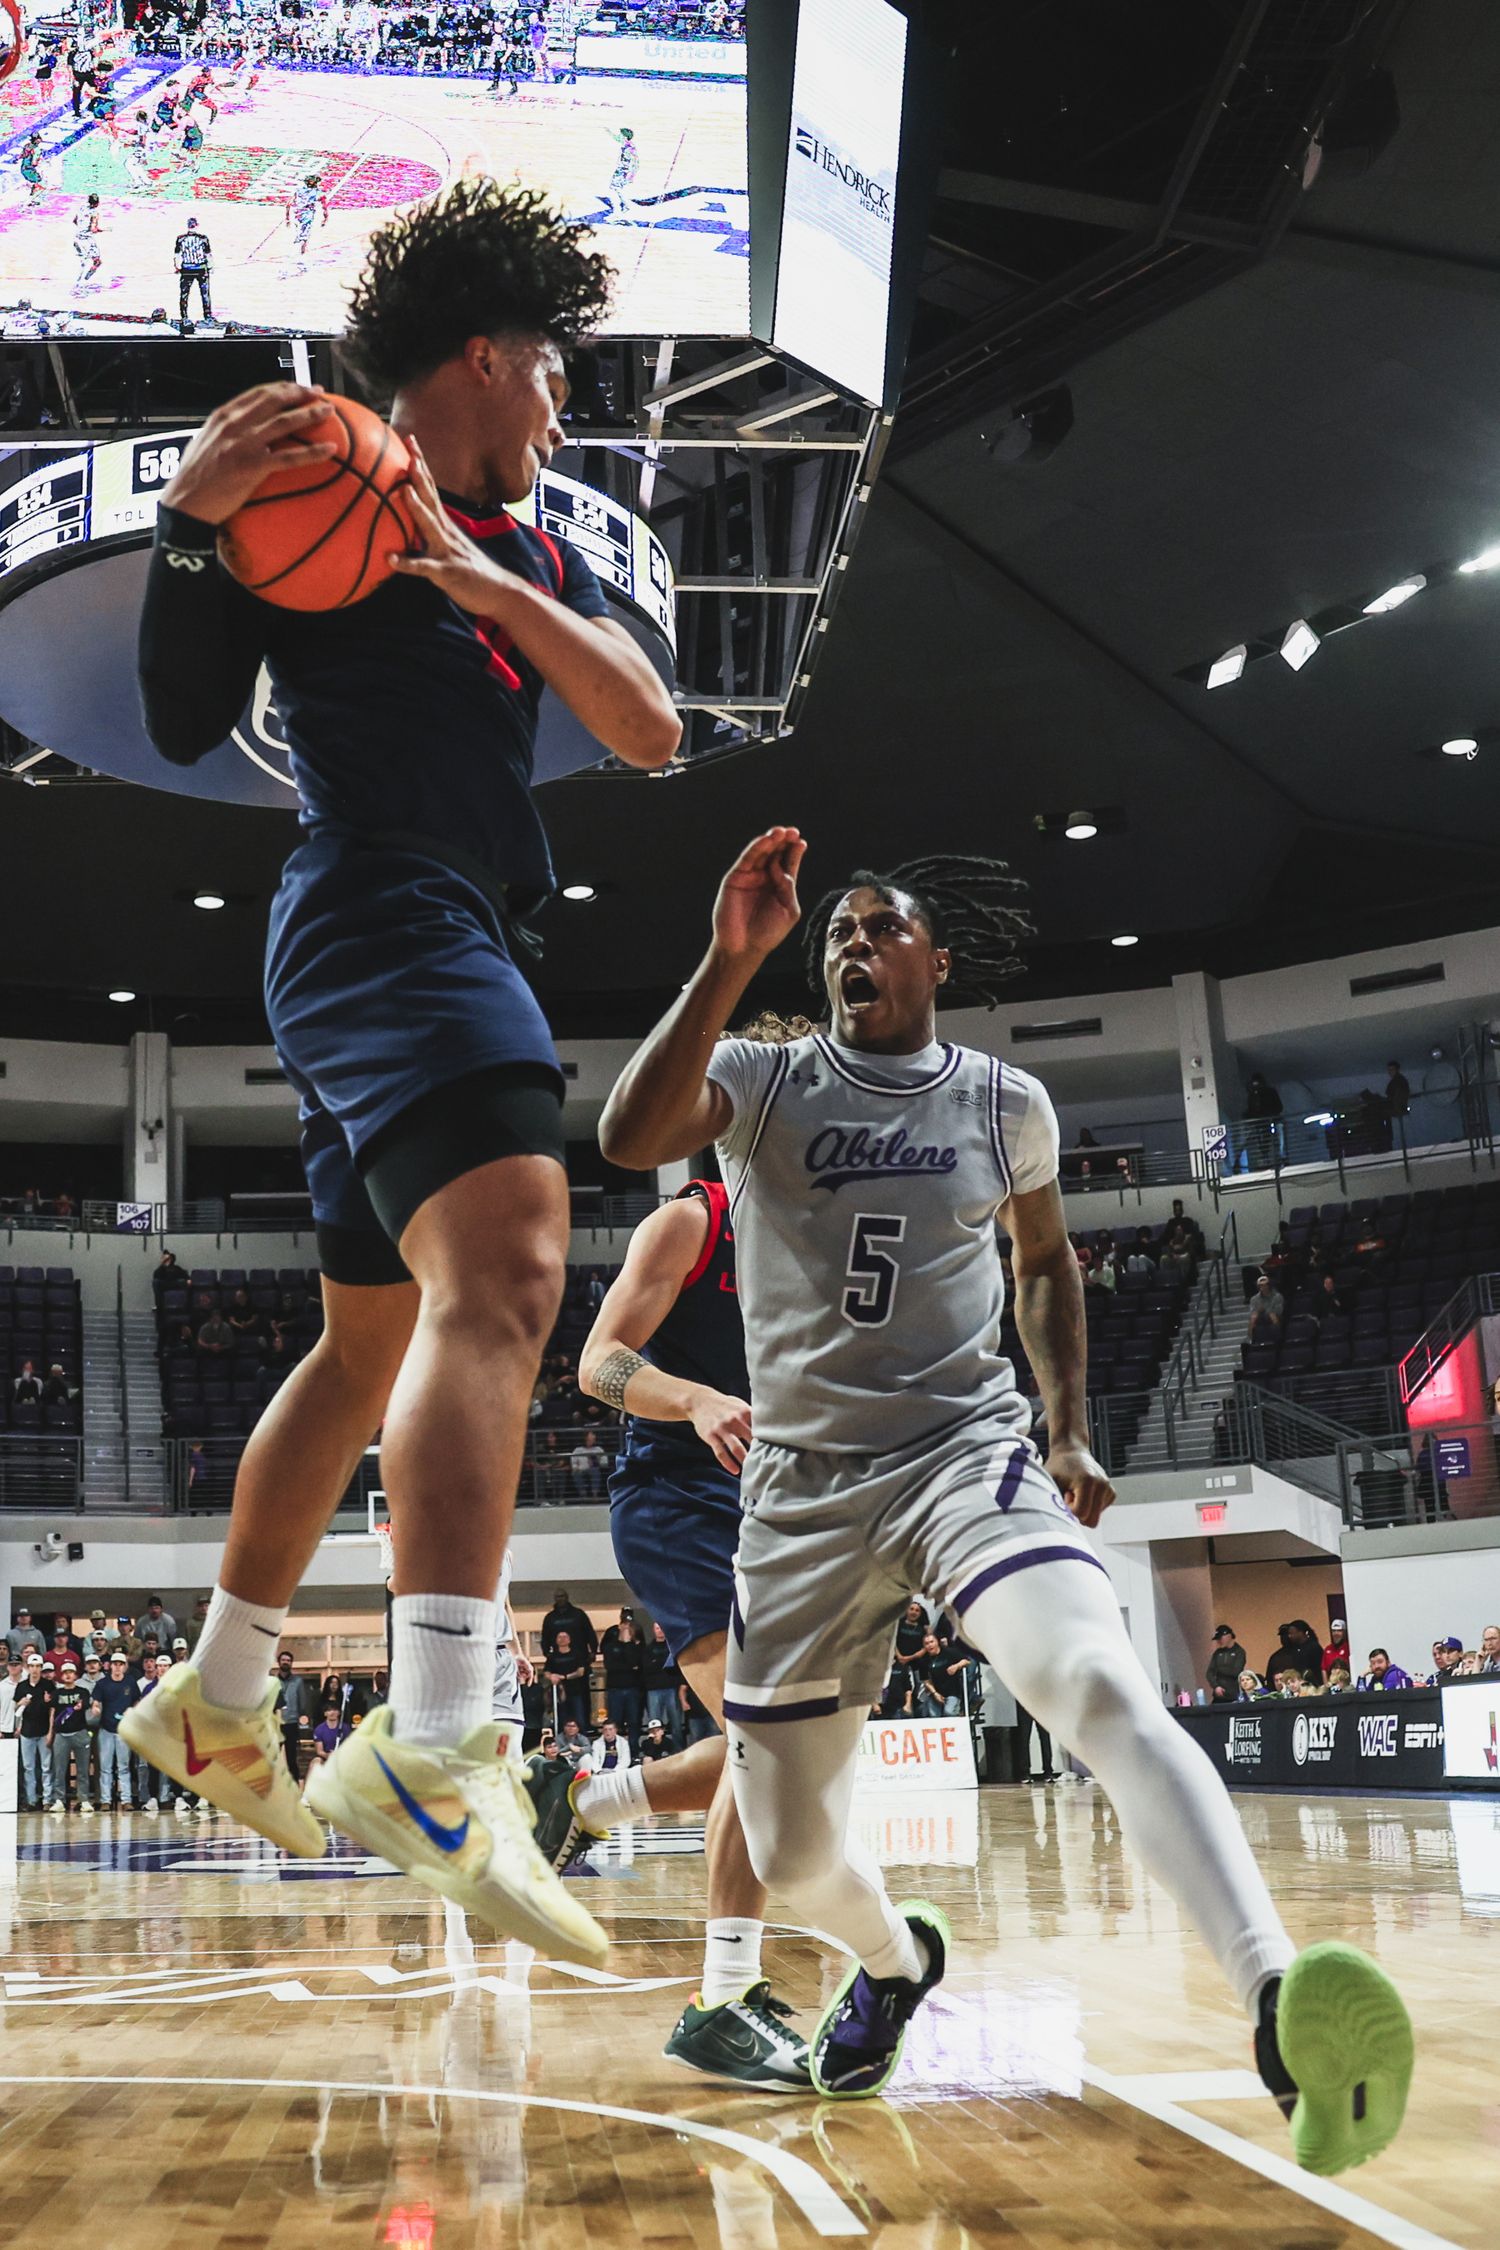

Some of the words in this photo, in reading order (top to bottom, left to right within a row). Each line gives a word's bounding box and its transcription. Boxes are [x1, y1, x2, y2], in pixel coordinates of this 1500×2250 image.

[813, 139, 891, 213] HENDRICK
[859, 196, 890, 223] HEALTH
[139, 447, 181, 483] 58
[1206, 1128, 1224, 1138] 108
[804, 1126, 958, 1173] Abilene
[1207, 1149, 1227, 1160] 109
[120, 1205, 138, 1214] 106
[131, 1220, 149, 1230] 107
[841, 1213, 907, 1328] 5
[1255, 1720, 1262, 1738] &
[1309, 1716, 1338, 1748] KEY
[1358, 1715, 1398, 1757] WAC
[880, 1727, 958, 1766] CAFE
